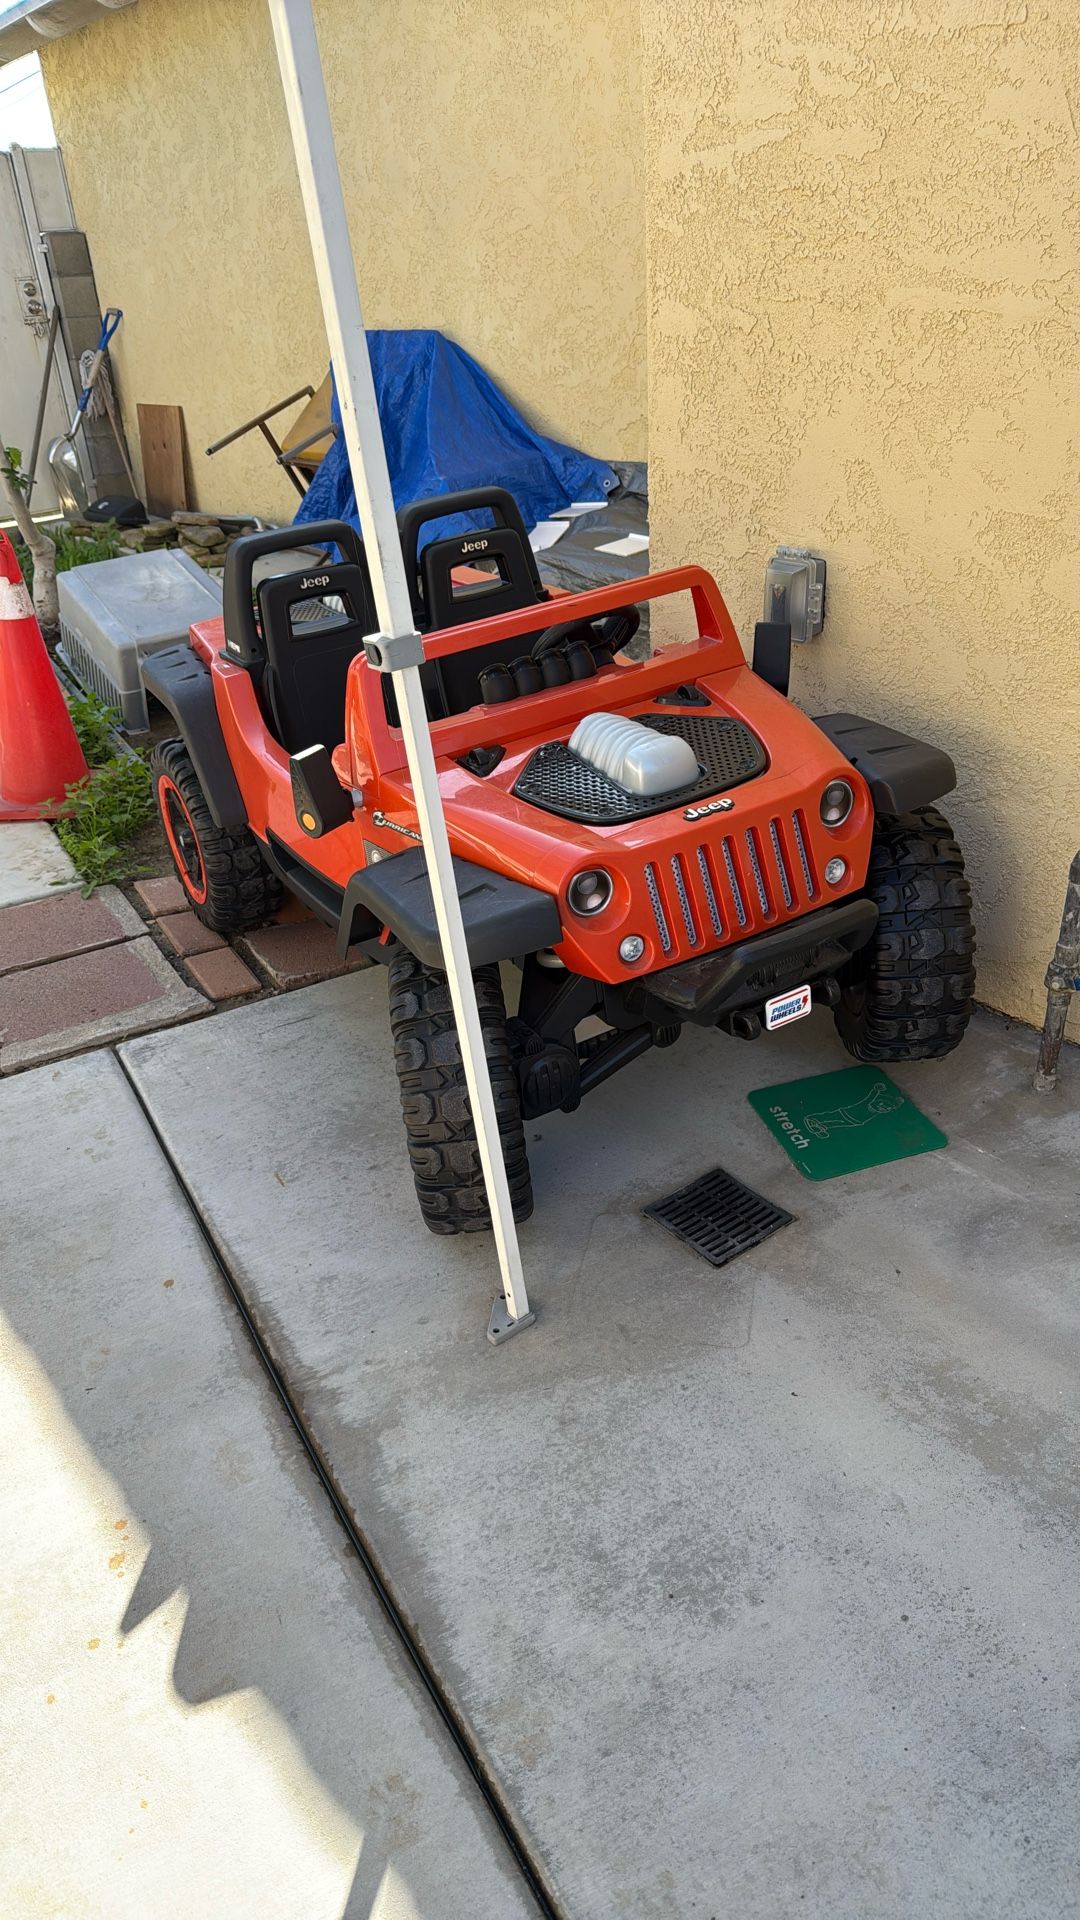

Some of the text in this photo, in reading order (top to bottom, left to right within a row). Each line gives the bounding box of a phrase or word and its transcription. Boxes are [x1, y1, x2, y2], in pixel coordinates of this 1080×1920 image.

[461, 539, 488, 553] Jeep
[300, 575, 330, 590] Jeep
[684, 798, 734, 819] Jeep
[770, 1005, 802, 1023] WHEELS
[772, 997, 802, 1015] POWER
[769, 1105, 811, 1149] stretch
